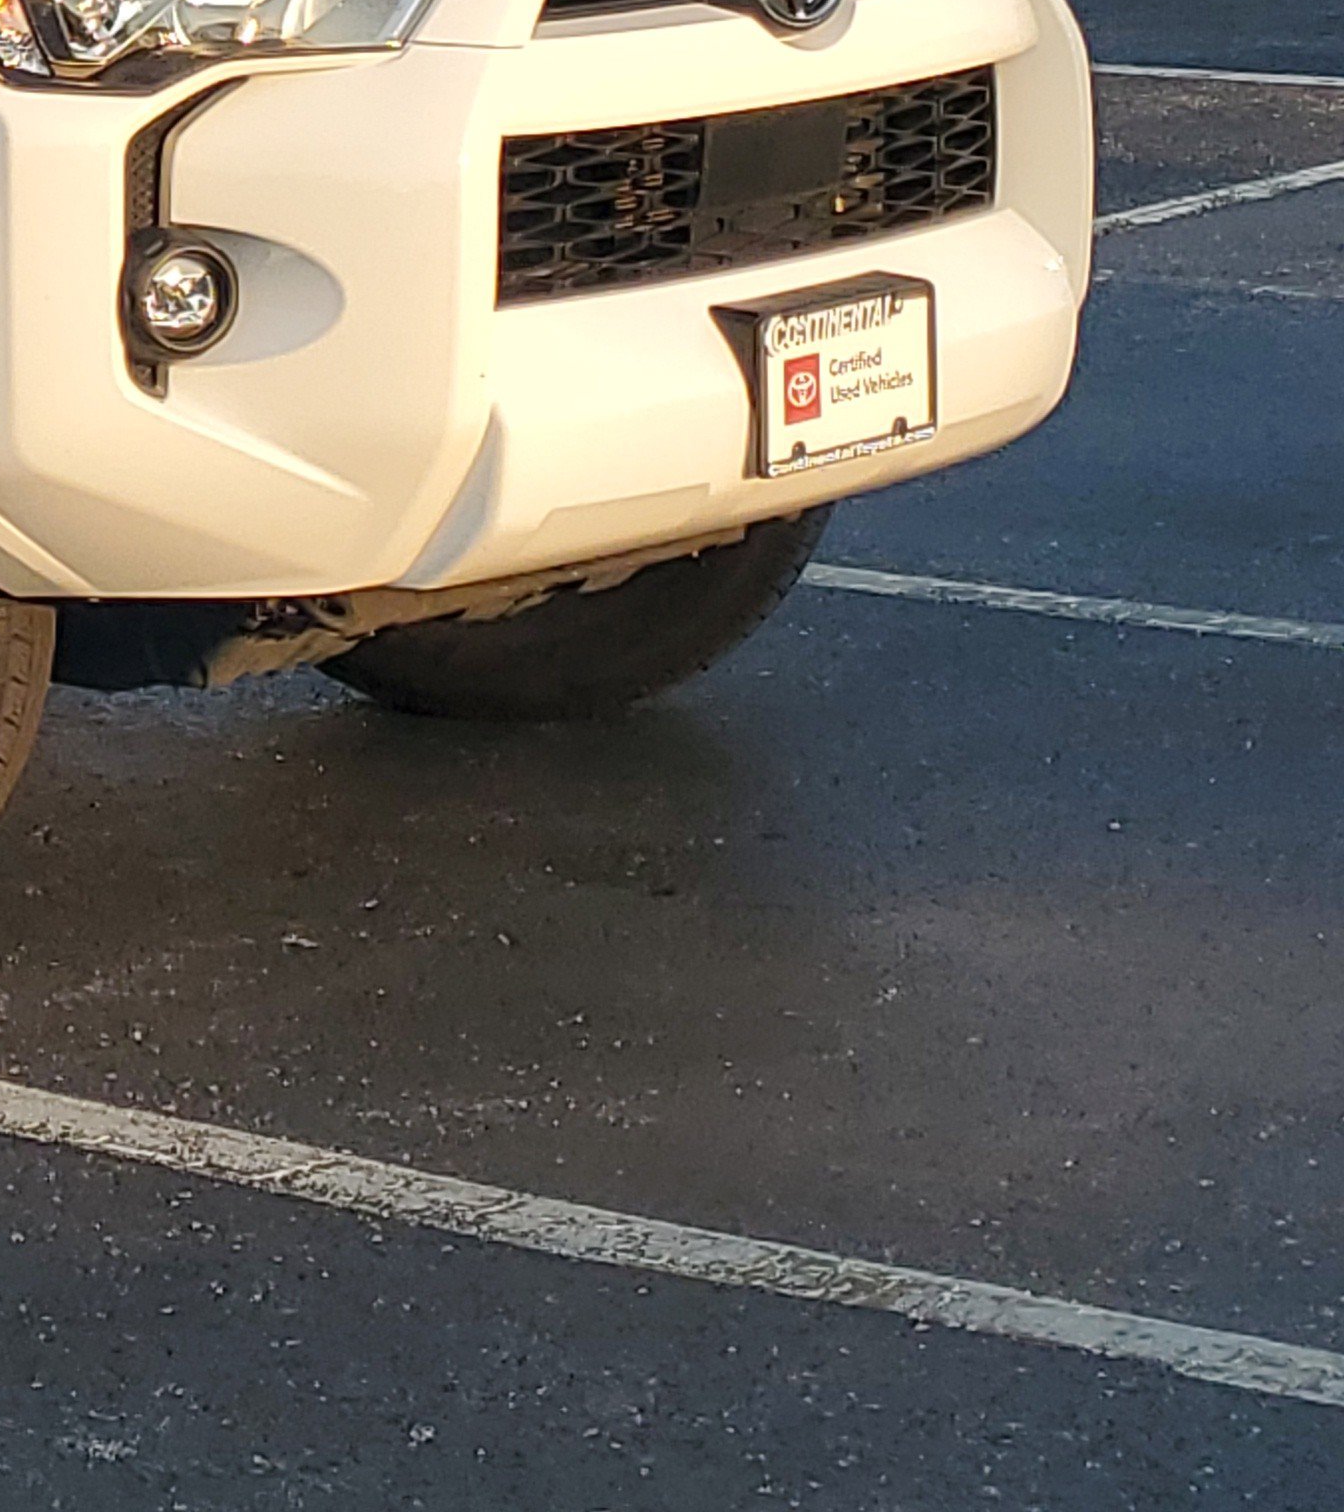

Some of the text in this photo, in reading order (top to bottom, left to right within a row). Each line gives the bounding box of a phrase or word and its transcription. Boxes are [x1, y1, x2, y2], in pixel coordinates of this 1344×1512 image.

[828, 346, 883, 377] Certified
[830, 370, 914, 404] Used Vehicles
